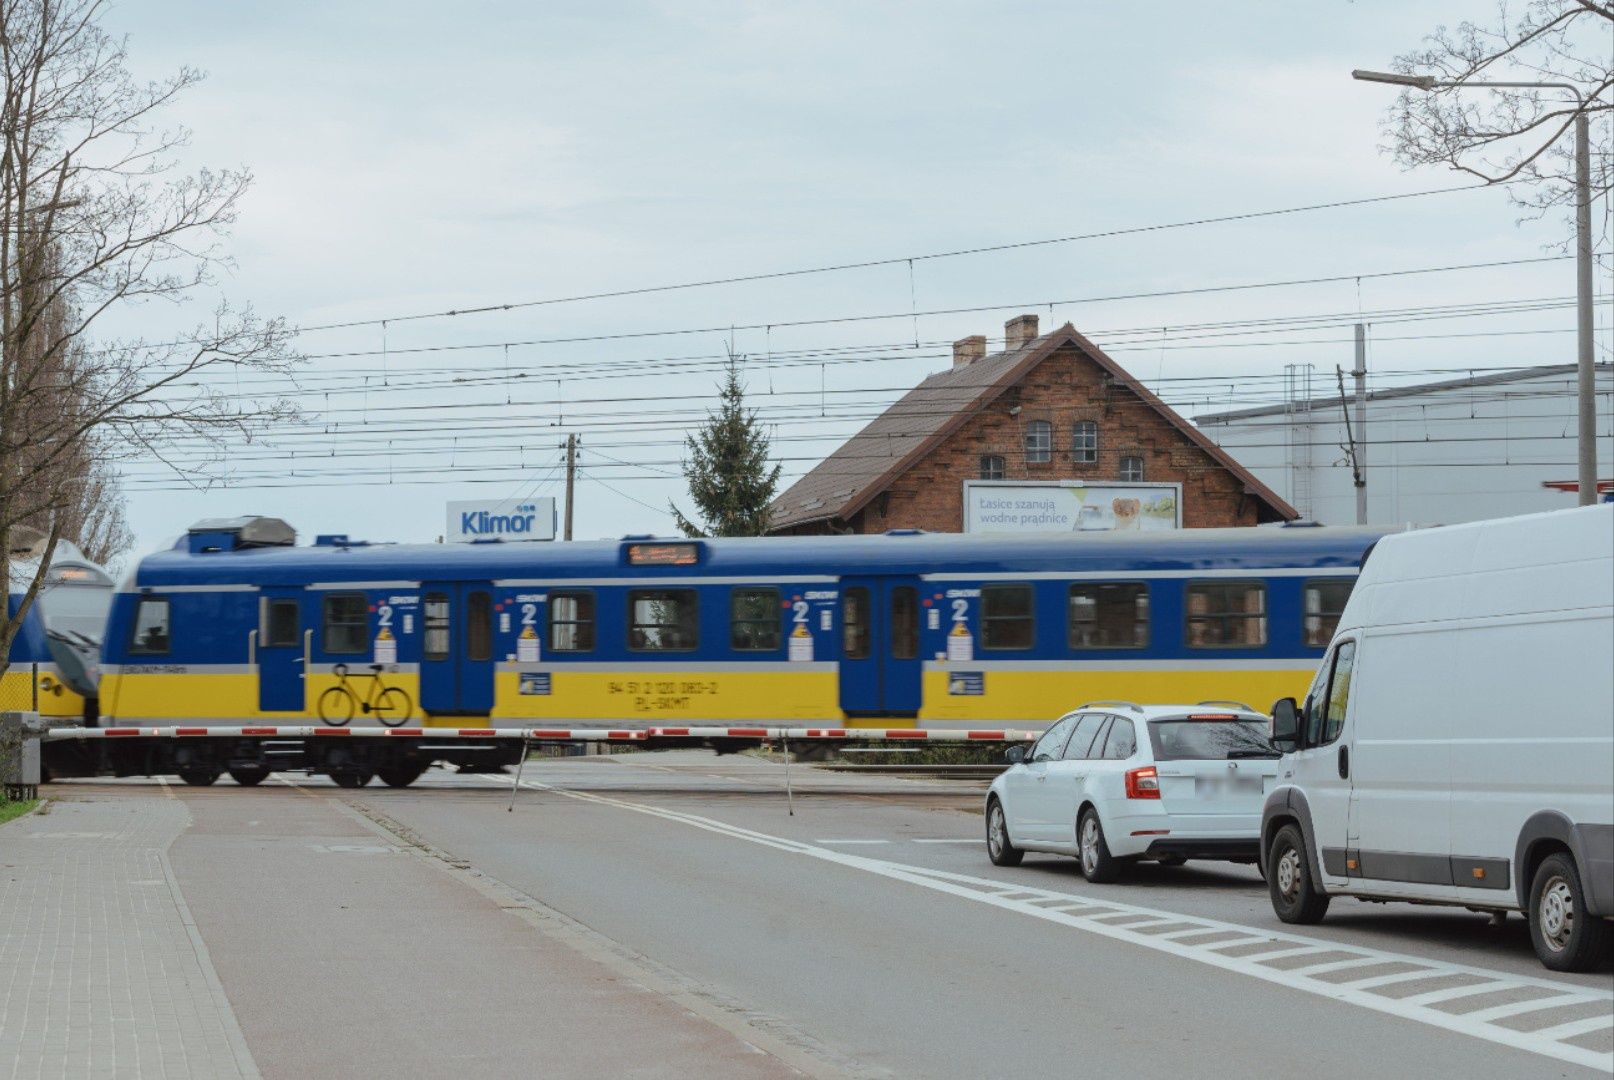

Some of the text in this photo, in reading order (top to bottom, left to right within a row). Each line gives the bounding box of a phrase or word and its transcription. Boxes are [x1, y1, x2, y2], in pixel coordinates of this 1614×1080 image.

[1015, 499, 1055, 511] szanują
[462, 511, 535, 533] Klimor
[980, 513, 1068, 526] wodne prądnice
[378, 606, 393, 625] 2
[521, 604, 537, 624] 2
[793, 601, 809, 622] 2
[951, 600, 968, 621] 2
